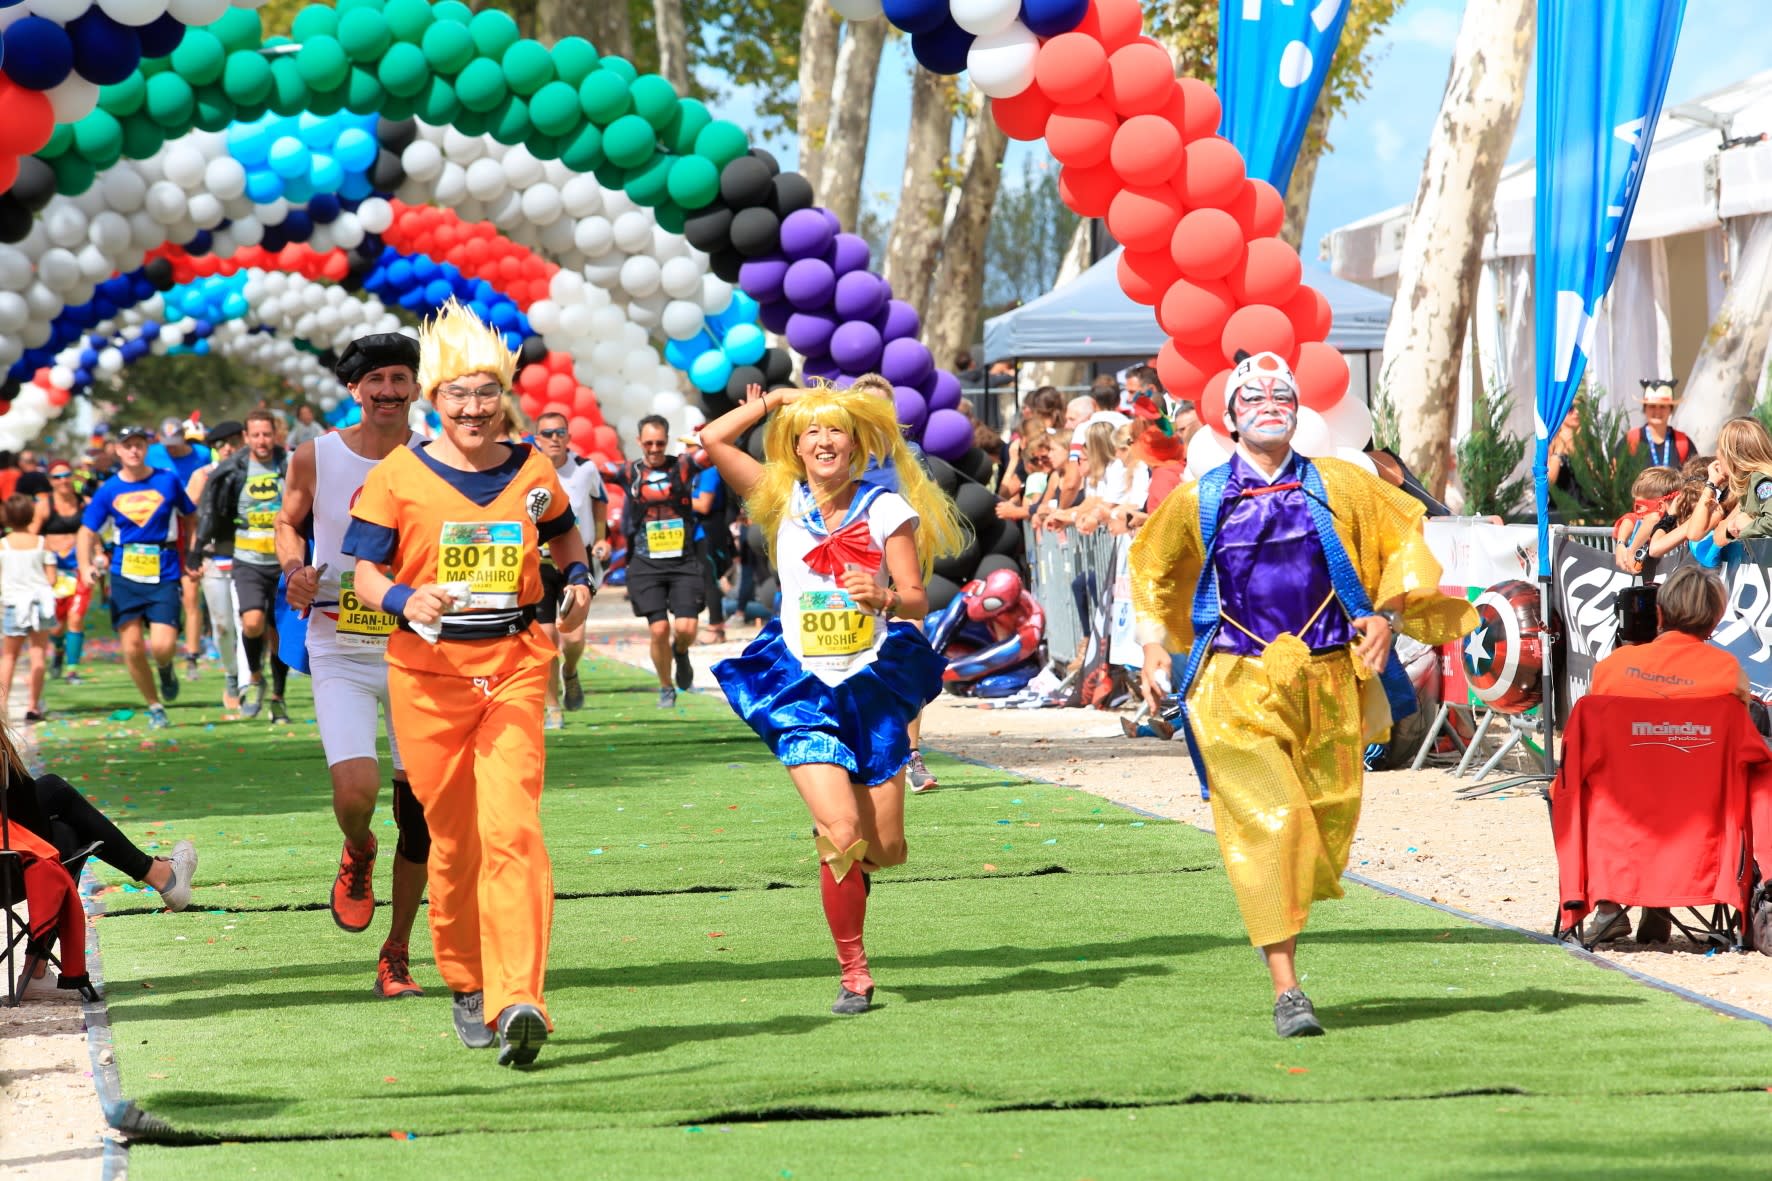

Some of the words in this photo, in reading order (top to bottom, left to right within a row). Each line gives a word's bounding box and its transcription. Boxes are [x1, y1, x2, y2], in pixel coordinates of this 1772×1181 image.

[443, 545, 519, 568] 8018
[446, 570, 515, 583] MASAHIRO
[802, 611, 867, 633] 8017
[817, 632, 857, 646] YOSHIE
